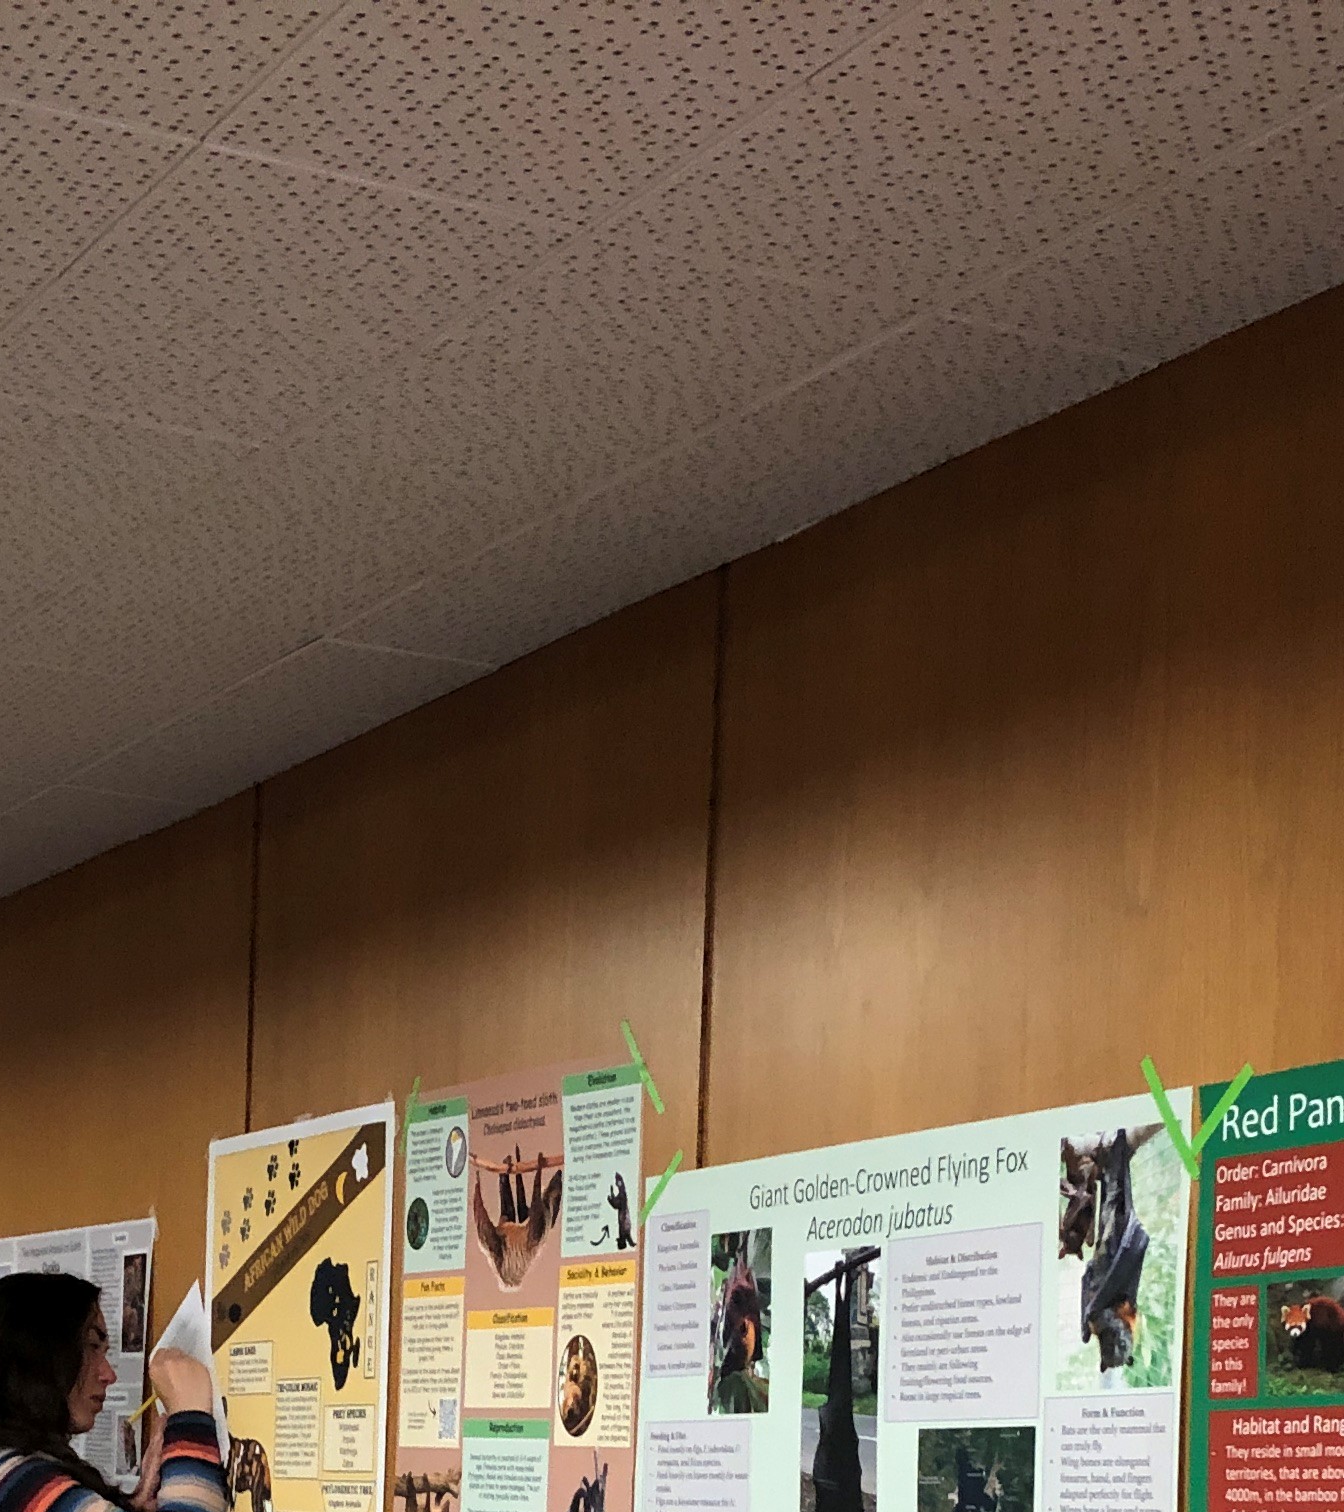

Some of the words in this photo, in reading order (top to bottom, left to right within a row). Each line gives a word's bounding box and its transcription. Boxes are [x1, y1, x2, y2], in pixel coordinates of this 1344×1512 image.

[1222, 1093, 1278, 1141] Red
[749, 1184, 789, 1210] Giant
[793, 1157, 931, 1204] Golden-Crowned
[938, 1153, 990, 1187] Flying
[996, 1147, 1029, 1175] Fox
[1216, 1163, 1258, 1184] Order:
[1261, 1155, 1328, 1178] Carnivora
[1216, 1190, 1262, 1212] Family:
[1264, 1182, 1327, 1206] Ailuridae
[806, 1206, 884, 1242] Acerodon
[886, 1201, 953, 1238] jubatus
[1215, 1223, 1257, 1241] Genus
[1259, 1215, 1285, 1237] and
[1287, 1211, 1344, 1236] Species:
[1214, 1251, 1260, 1270] Ailurus
[1262, 1246, 1311, 1269] fulgens
[1214, 1293, 1238, 1308] They
[1239, 1294, 1256, 1306] are
[1212, 1316, 1231, 1329] the
[1231, 1313, 1254, 1328] only
[1212, 1336, 1249, 1352] species
[1211, 1358, 1222, 1371] in
[1224, 1357, 1243, 1371] this
[1210, 1378, 1246, 1394] family!
[1232, 1416, 1281, 1435] Habitat
[1283, 1414, 1310, 1434] and
[1226, 1445, 1250, 1460] They
[1250, 1444, 1281, 1458] reside
[1282, 1446, 1293, 1457] in
[1294, 1442, 1323, 1458] small
